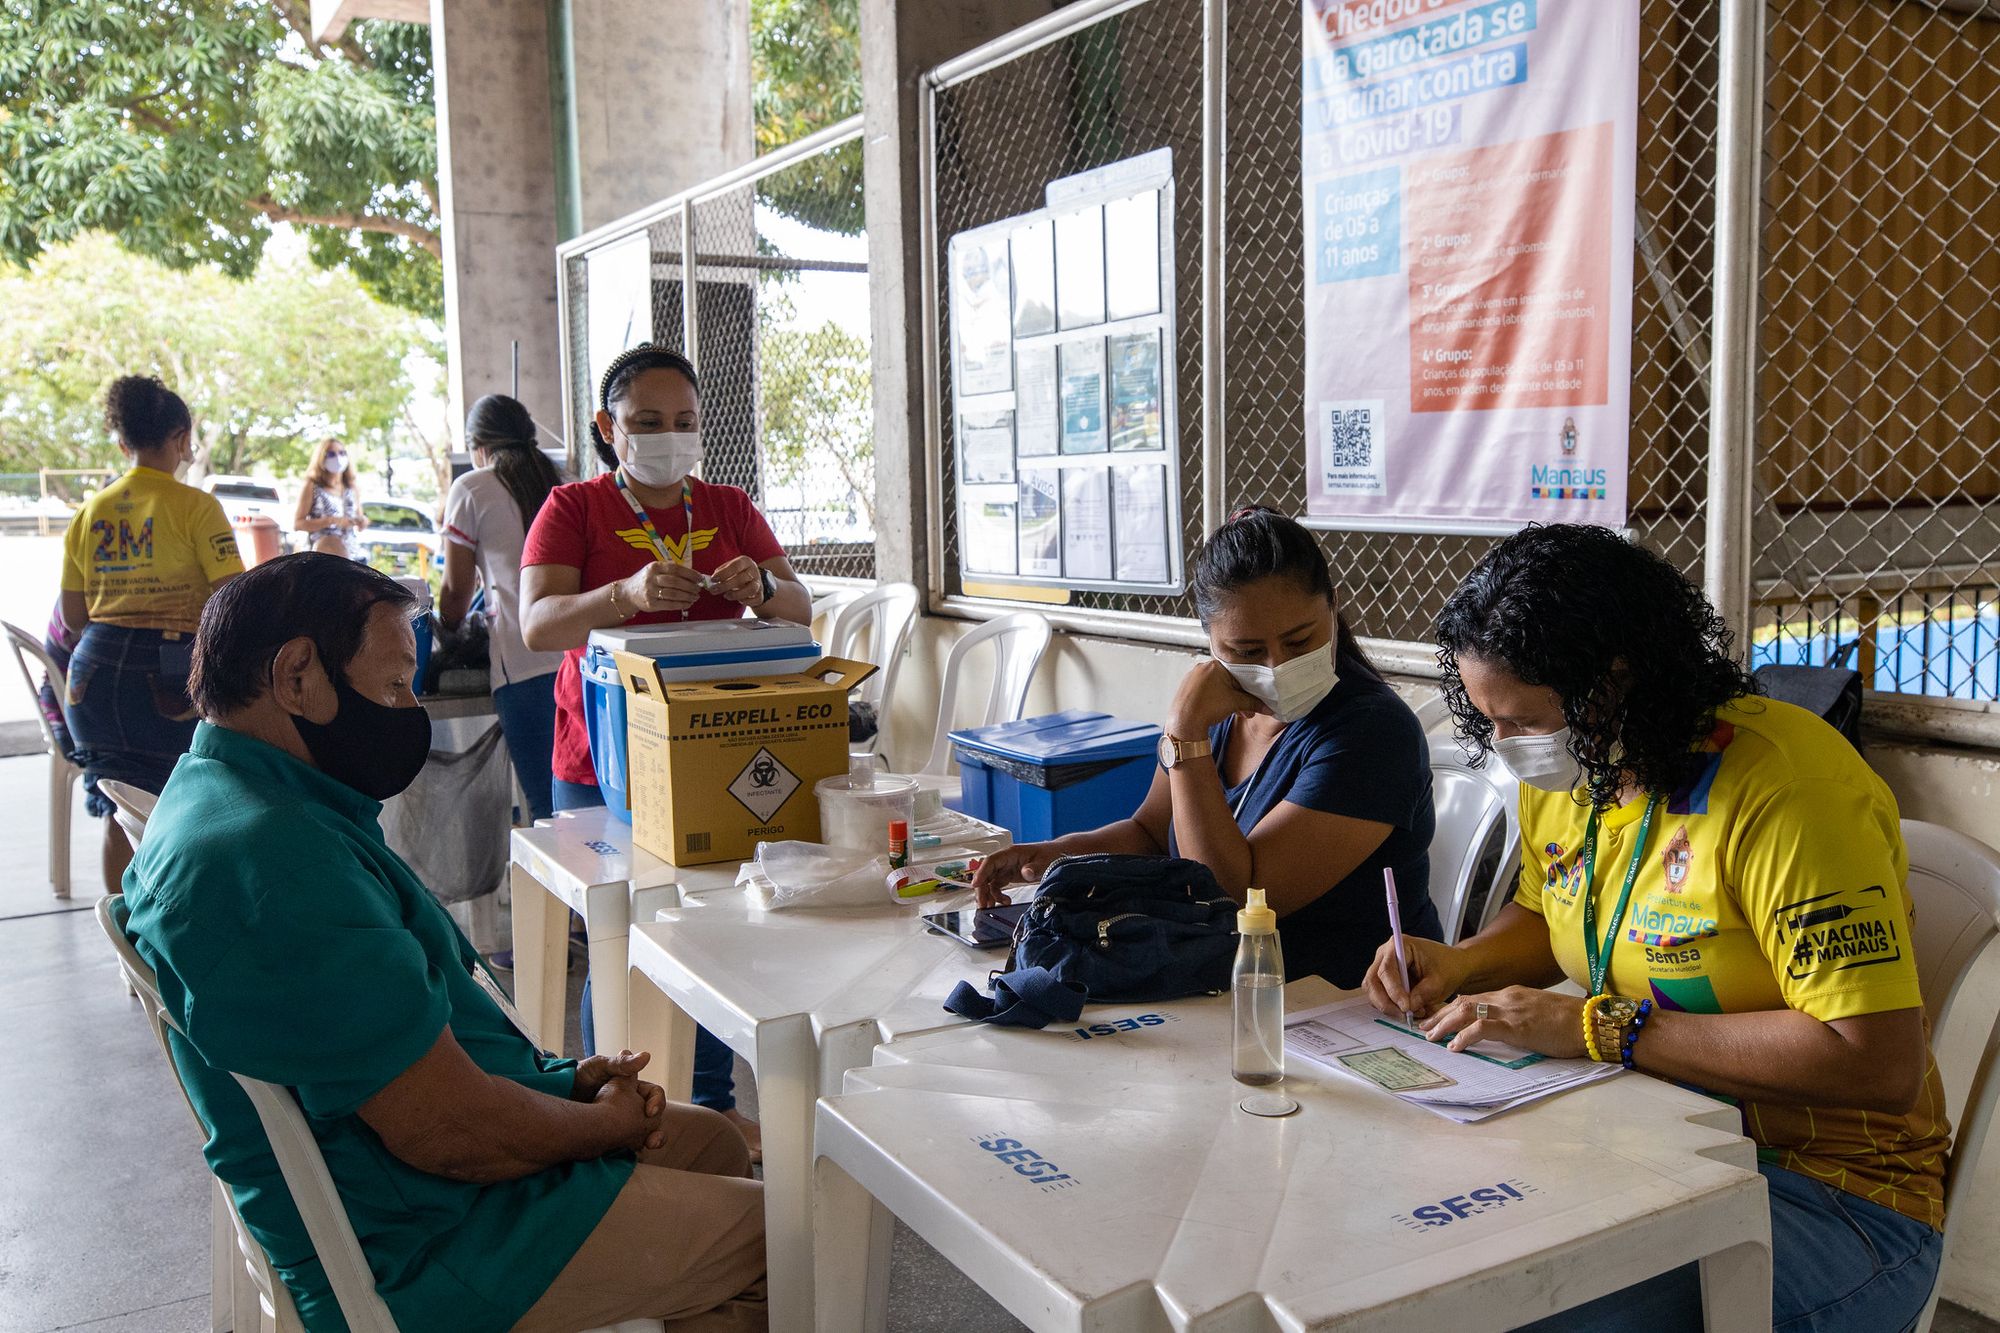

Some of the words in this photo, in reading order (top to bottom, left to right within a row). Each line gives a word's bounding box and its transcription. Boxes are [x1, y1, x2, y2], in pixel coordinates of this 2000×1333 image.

[1320, 52, 1348, 85] da
[1356, 11, 1484, 79] garotada
[1490, 0, 1527, 37] se
[1320, 78, 1414, 127] vacinar
[1418, 50, 1517, 102] contra
[1319, 142, 1333, 169] a
[1339, 107, 1453, 163] Covid-19
[1325, 187, 1390, 215] Crianças
[1324, 219, 1343, 241] de
[1346, 214, 1367, 238] 05
[1369, 216, 1380, 234] a
[1434, 233, 1471, 249] Grupo:
[1325, 246, 1338, 268] 11
[1342, 244, 1379, 265] anos
[1503, 296, 1518, 307] em
[1435, 347, 1473, 364] Grupo:
[1423, 367, 1458, 381] Crianças
[1459, 366, 1470, 378] da
[1423, 387, 1445, 398] anos,
[1446, 386, 1460, 396] em
[1555, 378, 1583, 390] idade
[1031, 474, 1055, 496] AVISO
[1531, 463, 1606, 486] Manaus
[91, 517, 154, 561] 2M
[689, 707, 780, 729] FLEXPELL
[796, 702, 833, 720] ECO
[747, 789, 782, 798] INFECTANTE
[747, 825, 785, 837] PERIGO
[1585, 836, 1594, 865] SEMSA
[1627, 857, 1640, 885] SEMSA
[1631, 901, 1719, 936] Manaus
[1689, 900, 1702, 911] de
[1644, 946, 1701, 965] Semsa
[1816, 936, 1890, 964] MANAUS
[1675, 963, 1702, 973] Municipal
[1074, 1014, 1165, 1040] SESI
[979, 1138, 1071, 1184] SESI
[1412, 1182, 1524, 1227] SESI
